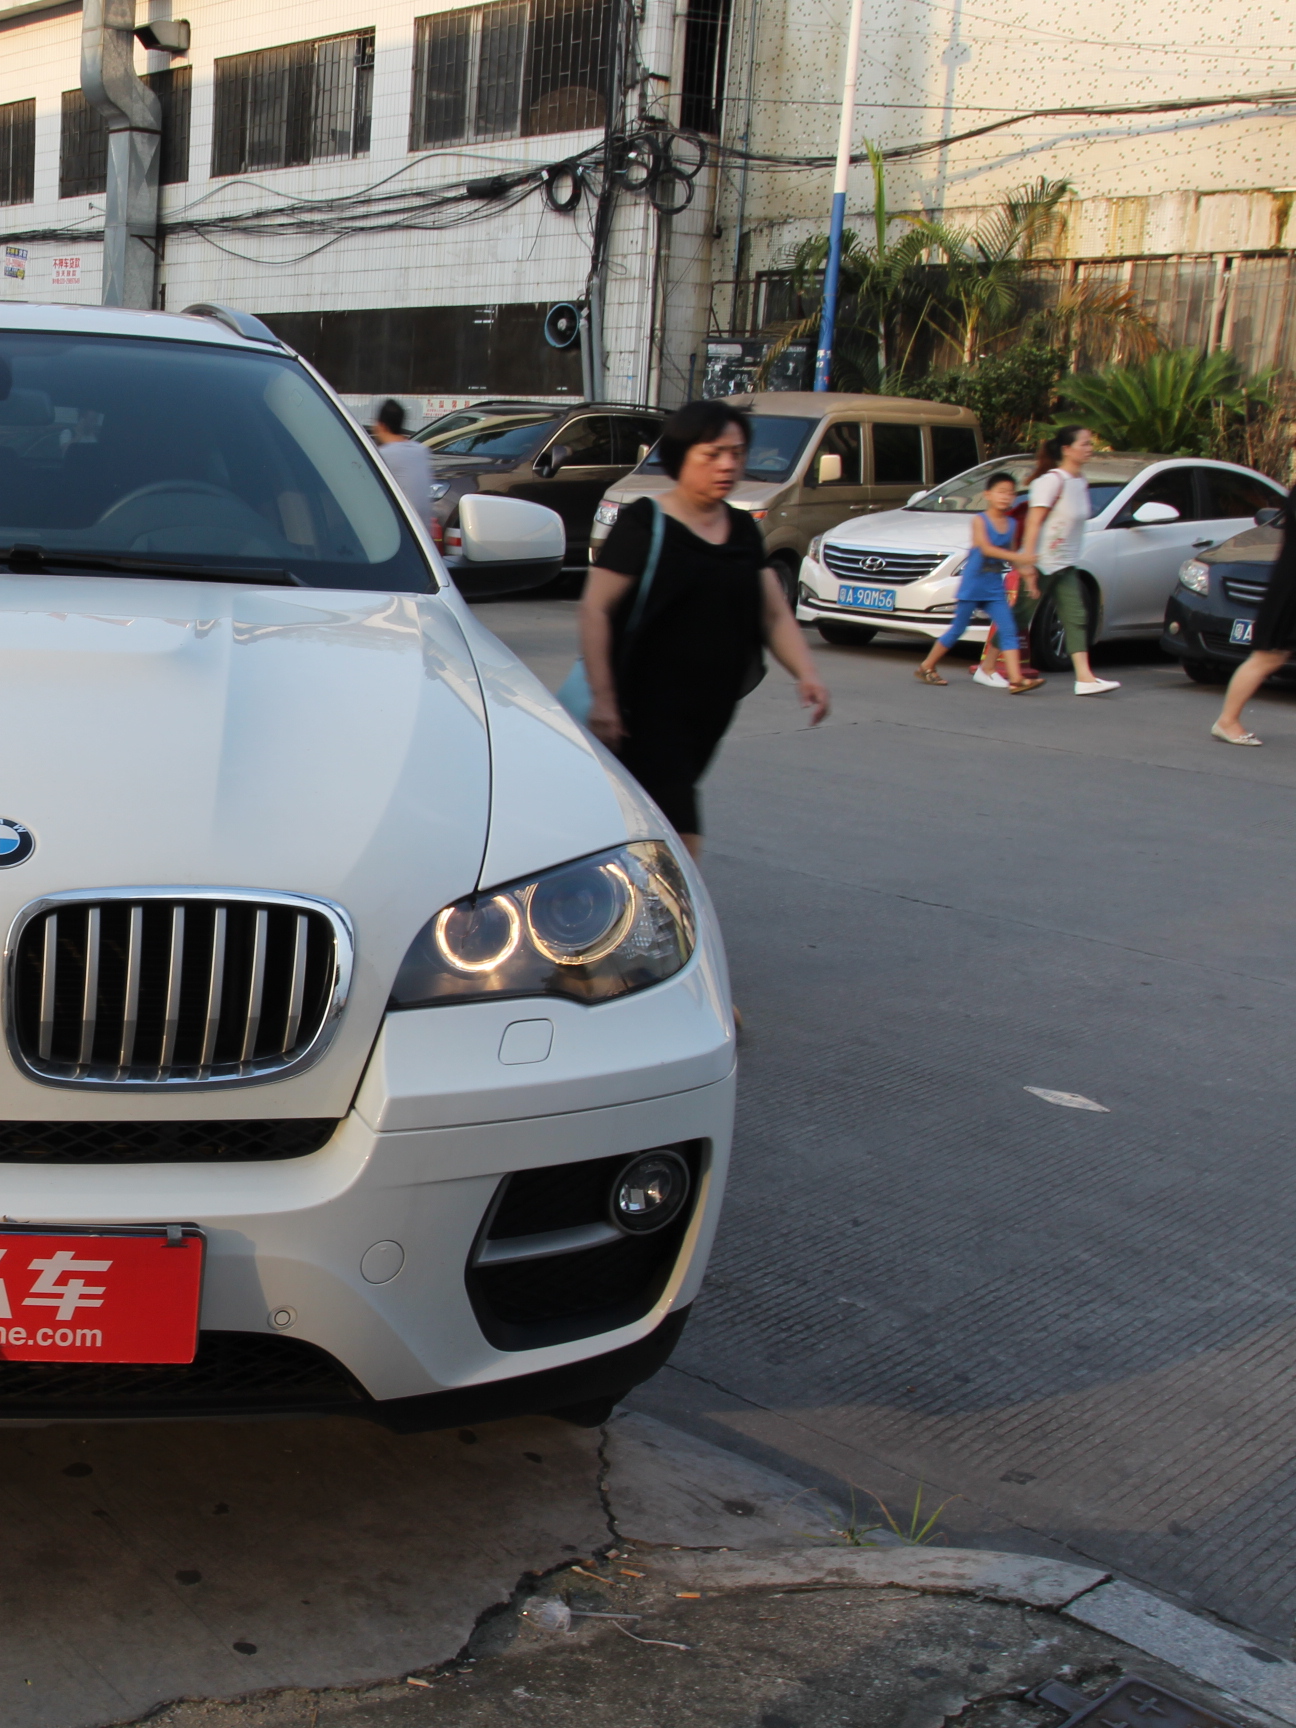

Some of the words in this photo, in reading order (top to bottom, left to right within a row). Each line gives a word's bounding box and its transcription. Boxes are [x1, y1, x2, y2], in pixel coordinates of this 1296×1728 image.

[52, 257, 81, 269] 不押车贷款
